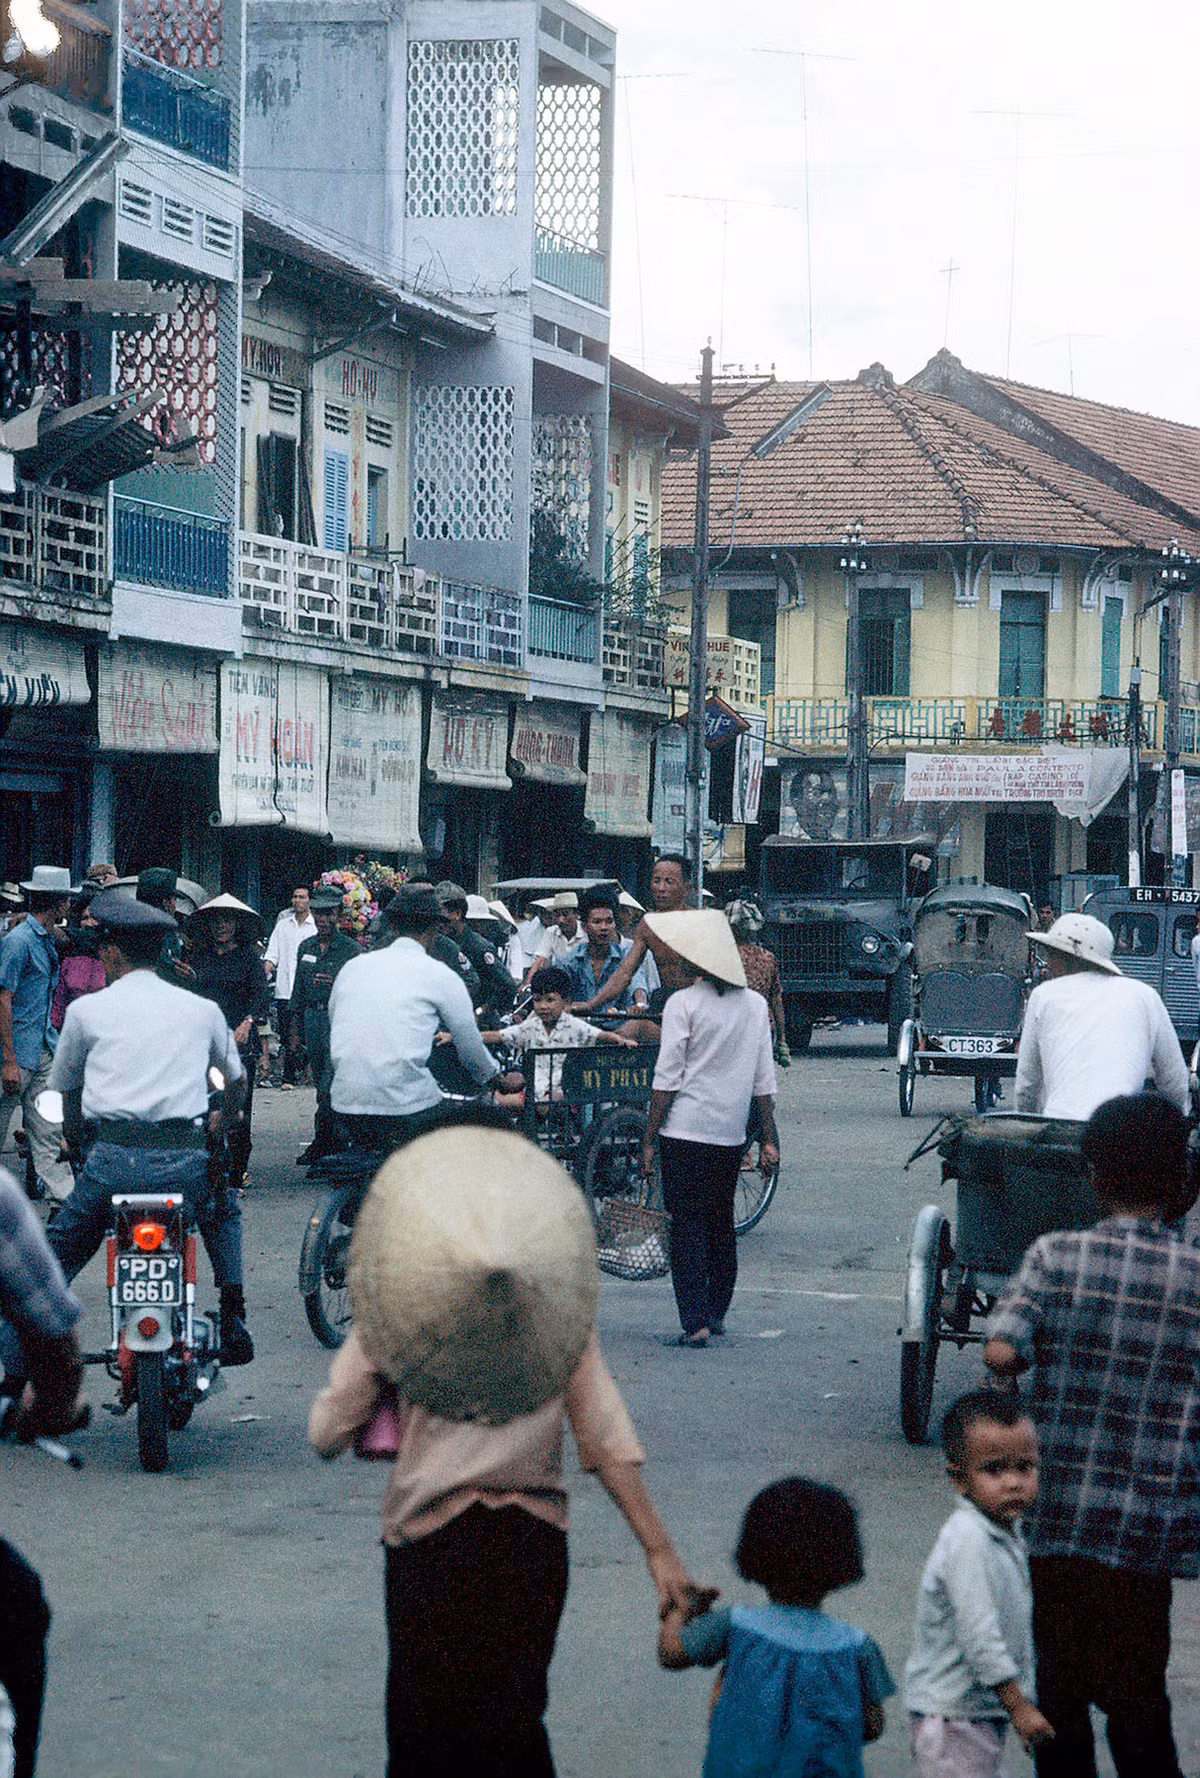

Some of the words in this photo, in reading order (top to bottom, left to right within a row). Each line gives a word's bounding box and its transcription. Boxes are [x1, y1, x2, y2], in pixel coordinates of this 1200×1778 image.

[1029, 764, 1084, 772] CONTENTO
[1136, 889, 1152, 901] EH
[130, 1259, 167, 1279] PD
